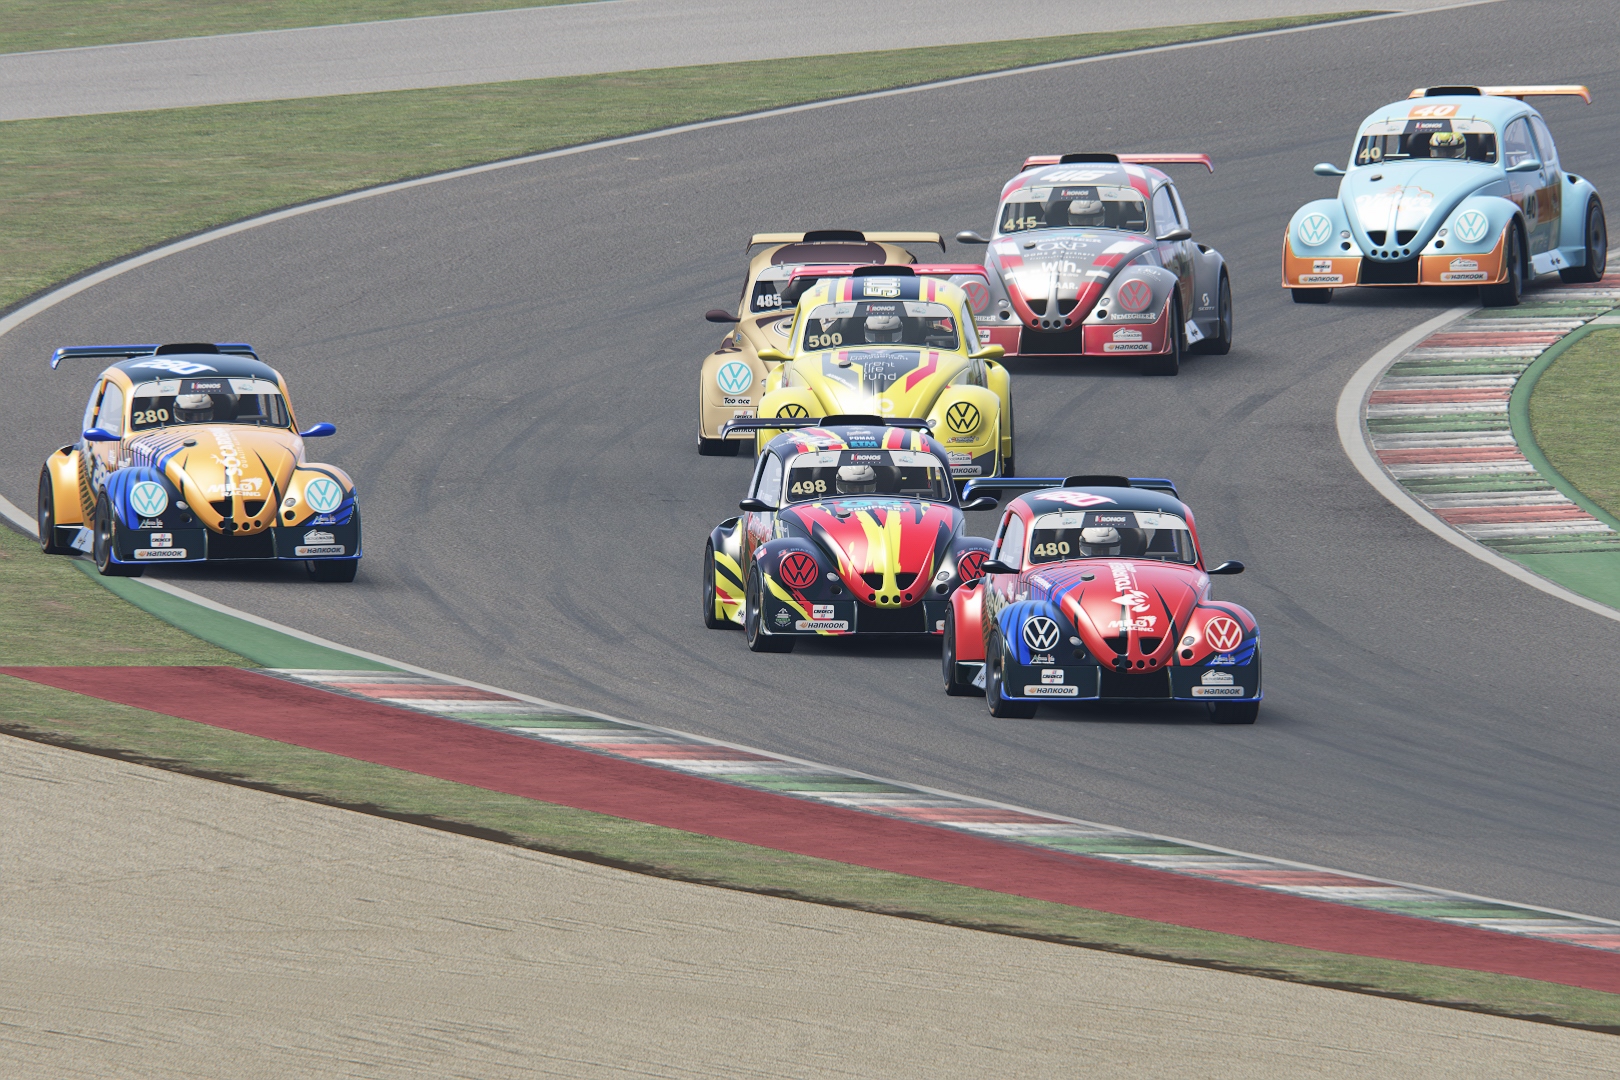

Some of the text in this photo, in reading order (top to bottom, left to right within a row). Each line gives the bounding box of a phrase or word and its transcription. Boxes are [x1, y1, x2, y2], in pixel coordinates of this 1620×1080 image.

[1414, 105, 1455, 116] 40
[1360, 147, 1381, 160] 40
[1004, 216, 1037, 231] 415
[757, 294, 782, 307] 485
[866, 304, 895, 312] KRONOS
[808, 333, 843, 347] 500
[863, 371, 896, 380] fund
[133, 408, 169, 424] 280
[791, 480, 827, 494] 498
[1095, 514, 1126, 522] KRONOS
[1033, 541, 1070, 556] 480
